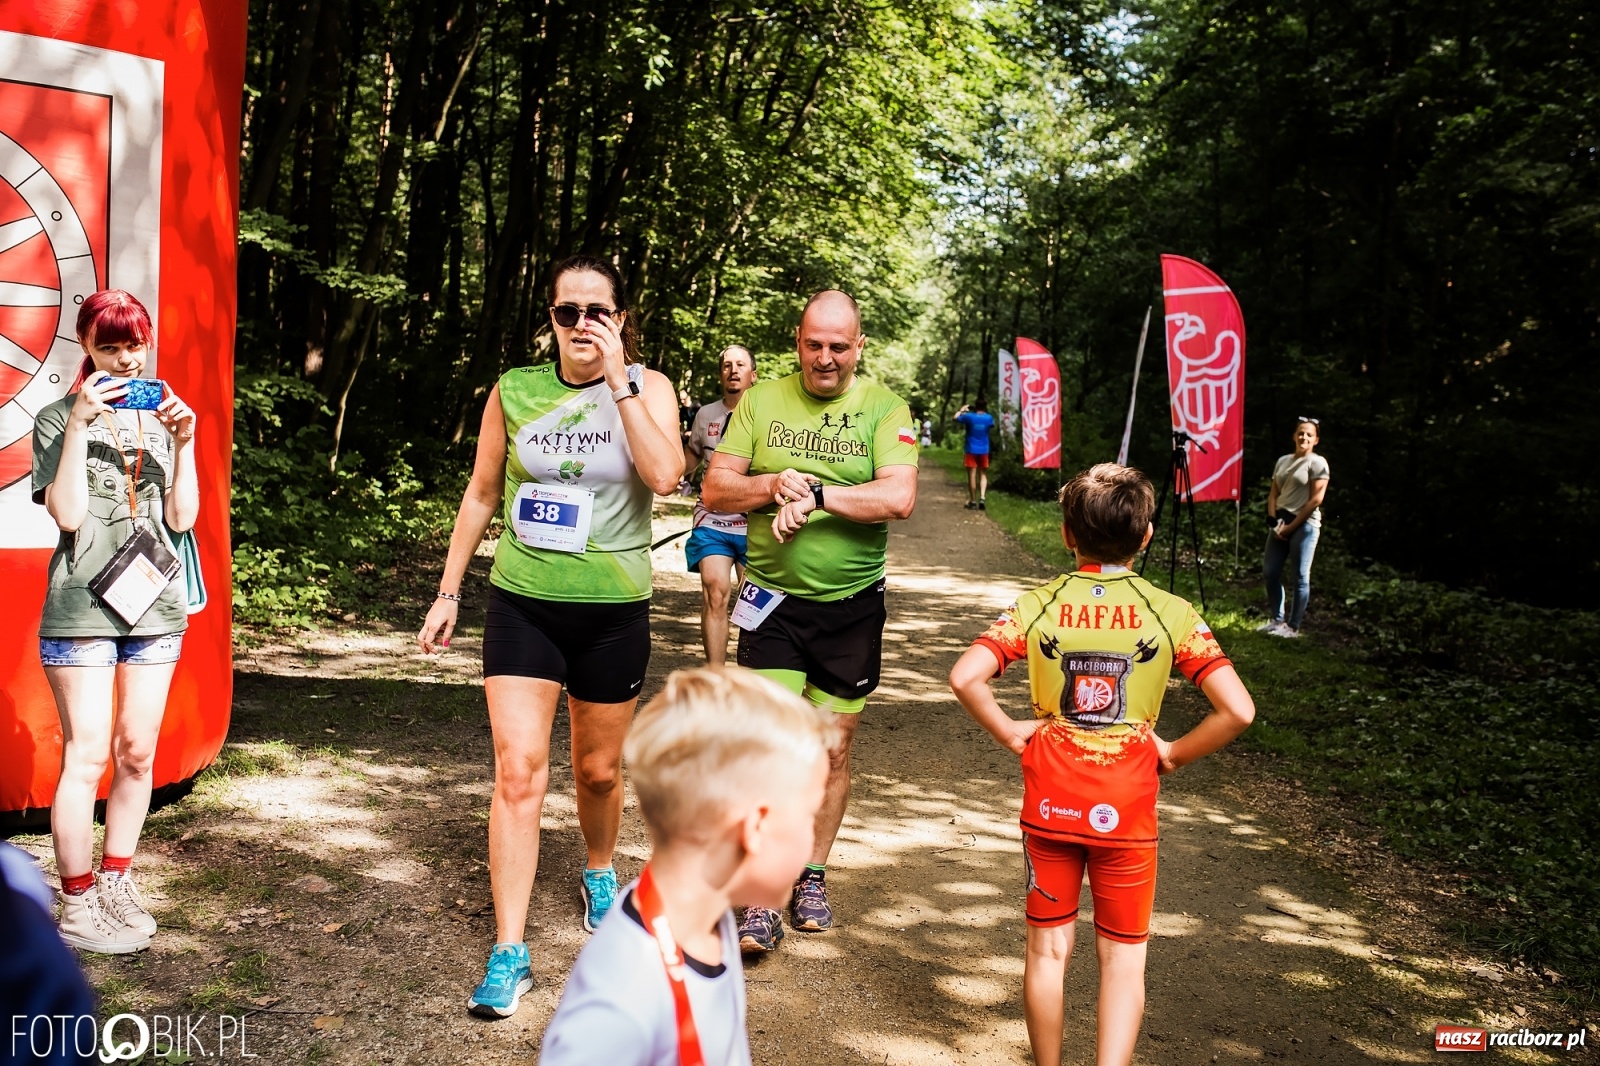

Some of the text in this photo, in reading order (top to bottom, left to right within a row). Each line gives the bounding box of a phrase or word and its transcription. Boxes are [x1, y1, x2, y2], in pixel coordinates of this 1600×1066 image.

[526, 430, 611, 446] AKTYWNI
[542, 445, 595, 455] LYSKI
[805, 451, 845, 464] biegu
[532, 502, 560, 522] 38
[742, 584, 760, 601] 43
[1058, 603, 1143, 630] RAFAŁ
[1051, 806, 1082, 819] MebRaj
